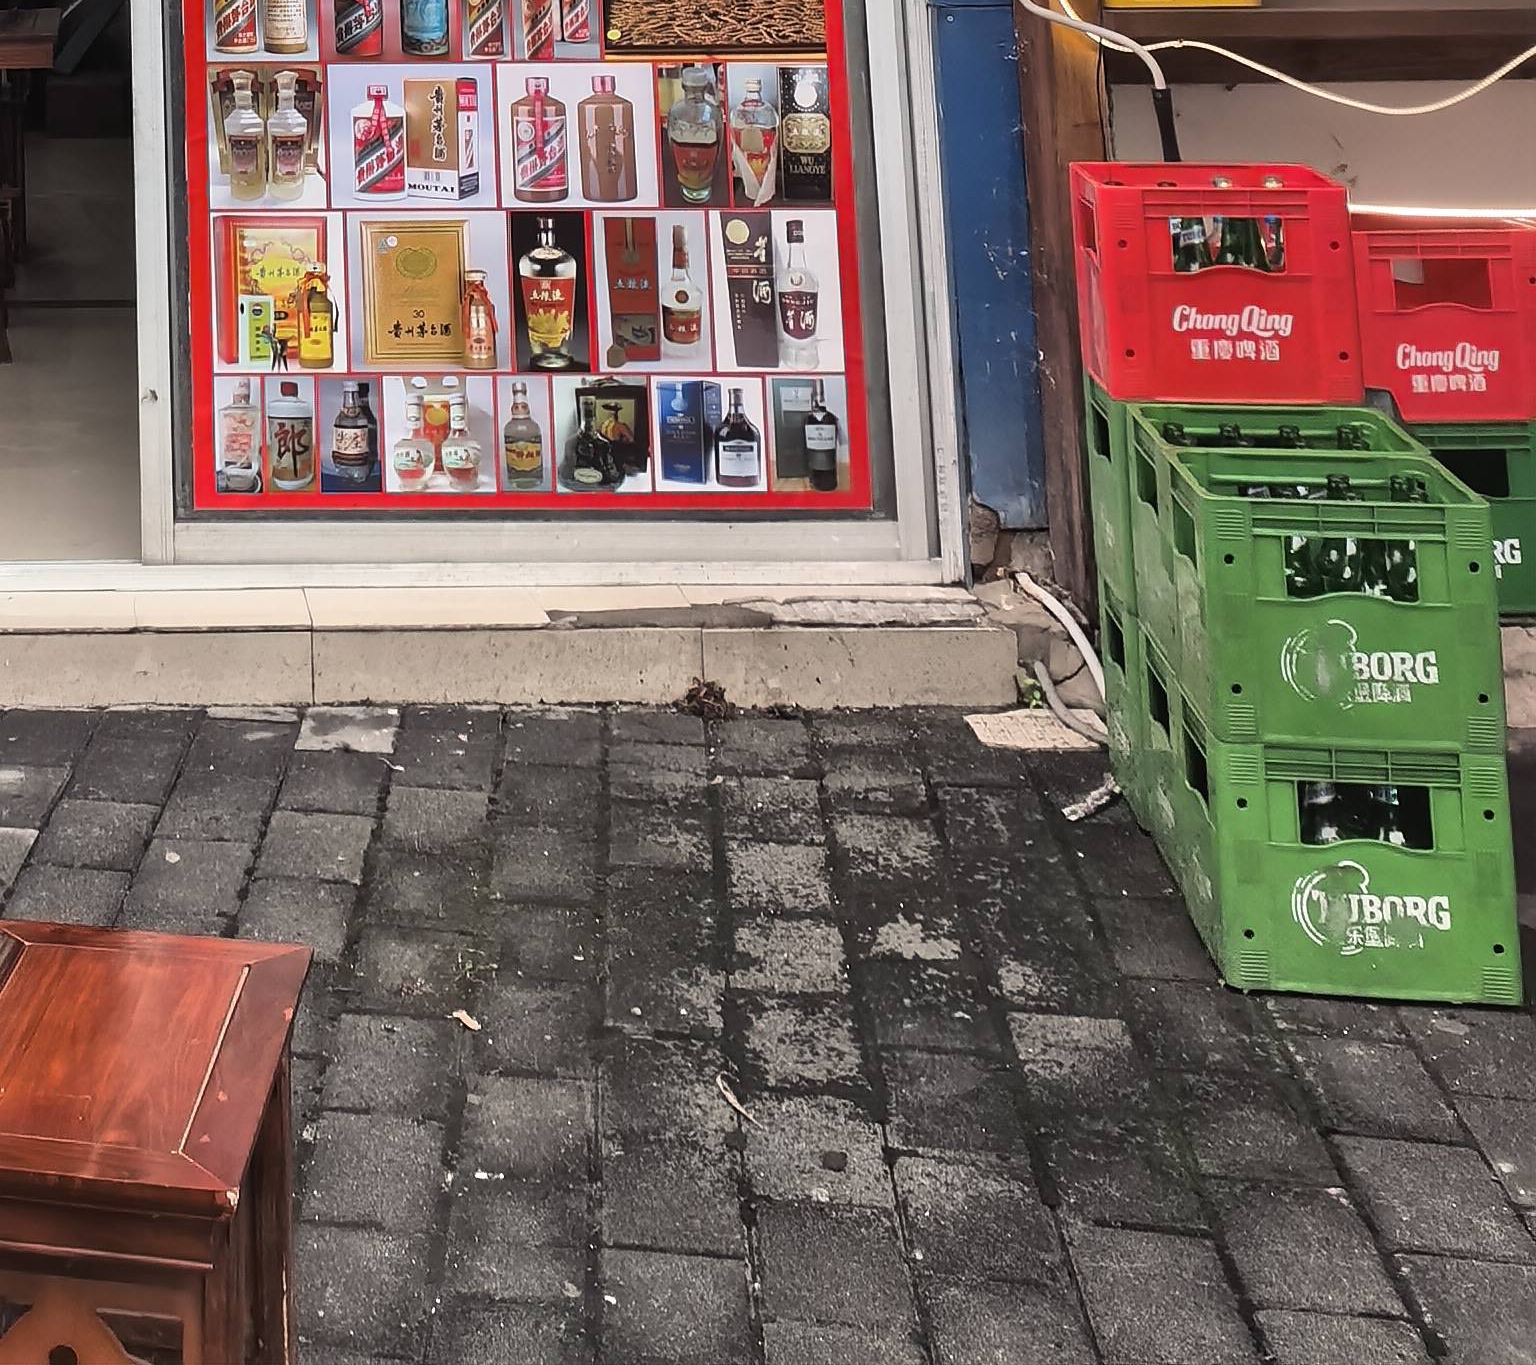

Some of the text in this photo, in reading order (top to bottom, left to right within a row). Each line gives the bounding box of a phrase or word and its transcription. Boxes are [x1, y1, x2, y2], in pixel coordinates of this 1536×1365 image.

[408, 182, 455, 194] MOUTAI
[413, 310, 425, 318] 30
[1342, 650, 1440, 685] BORG
